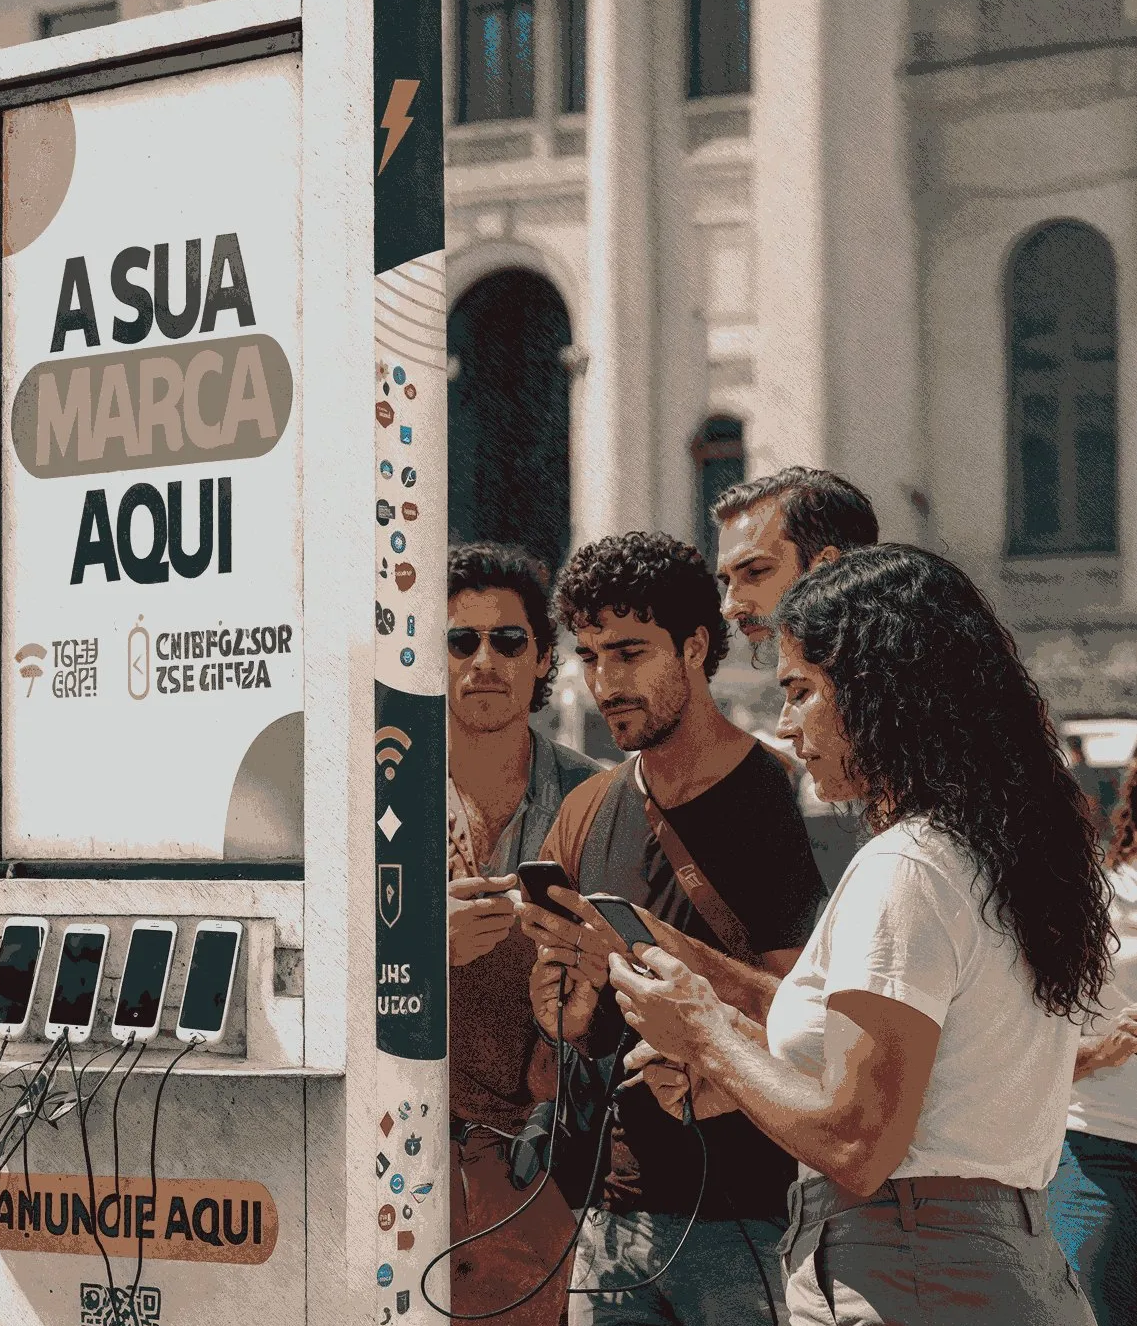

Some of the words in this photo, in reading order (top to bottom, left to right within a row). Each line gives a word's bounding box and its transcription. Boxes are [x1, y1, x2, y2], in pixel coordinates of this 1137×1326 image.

[50, 256, 101, 353] A
[111, 233, 256, 344] SUA
[36, 344, 277, 466] MARCA
[70, 477, 232, 585] AQUI
[165, 1195, 262, 1247] AQUI
